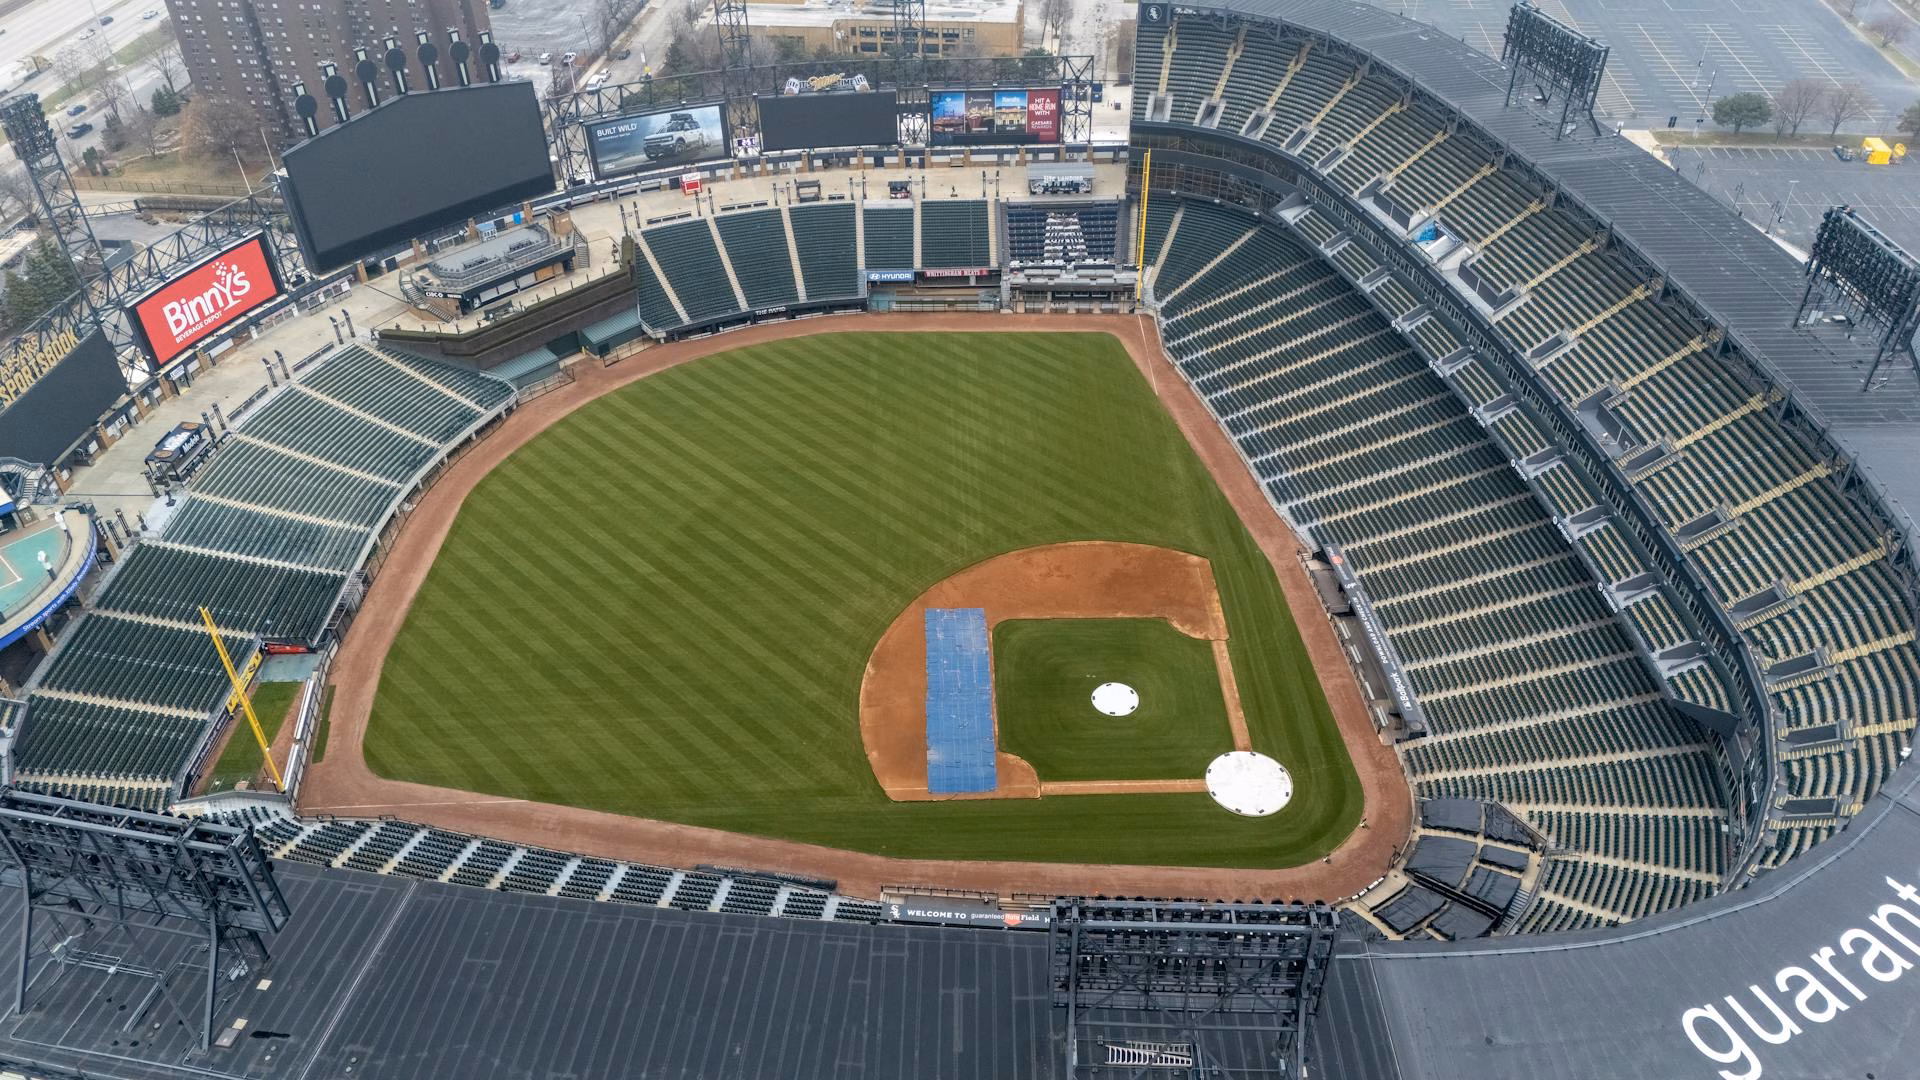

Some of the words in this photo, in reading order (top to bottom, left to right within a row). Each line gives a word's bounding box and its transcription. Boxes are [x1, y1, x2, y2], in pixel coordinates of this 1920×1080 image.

[597, 127, 616, 136] BUILT
[618, 123, 637, 132] WILD
[176, 324, 204, 343] BEVERAGE
[204, 311, 222, 327] DEPOT
[0, 327, 80, 407] SPORTSBOOK
[22, 615, 42, 632] Stream
[1391, 672, 1409, 700] Ballpark
[907, 909, 953, 918] WELCOME
